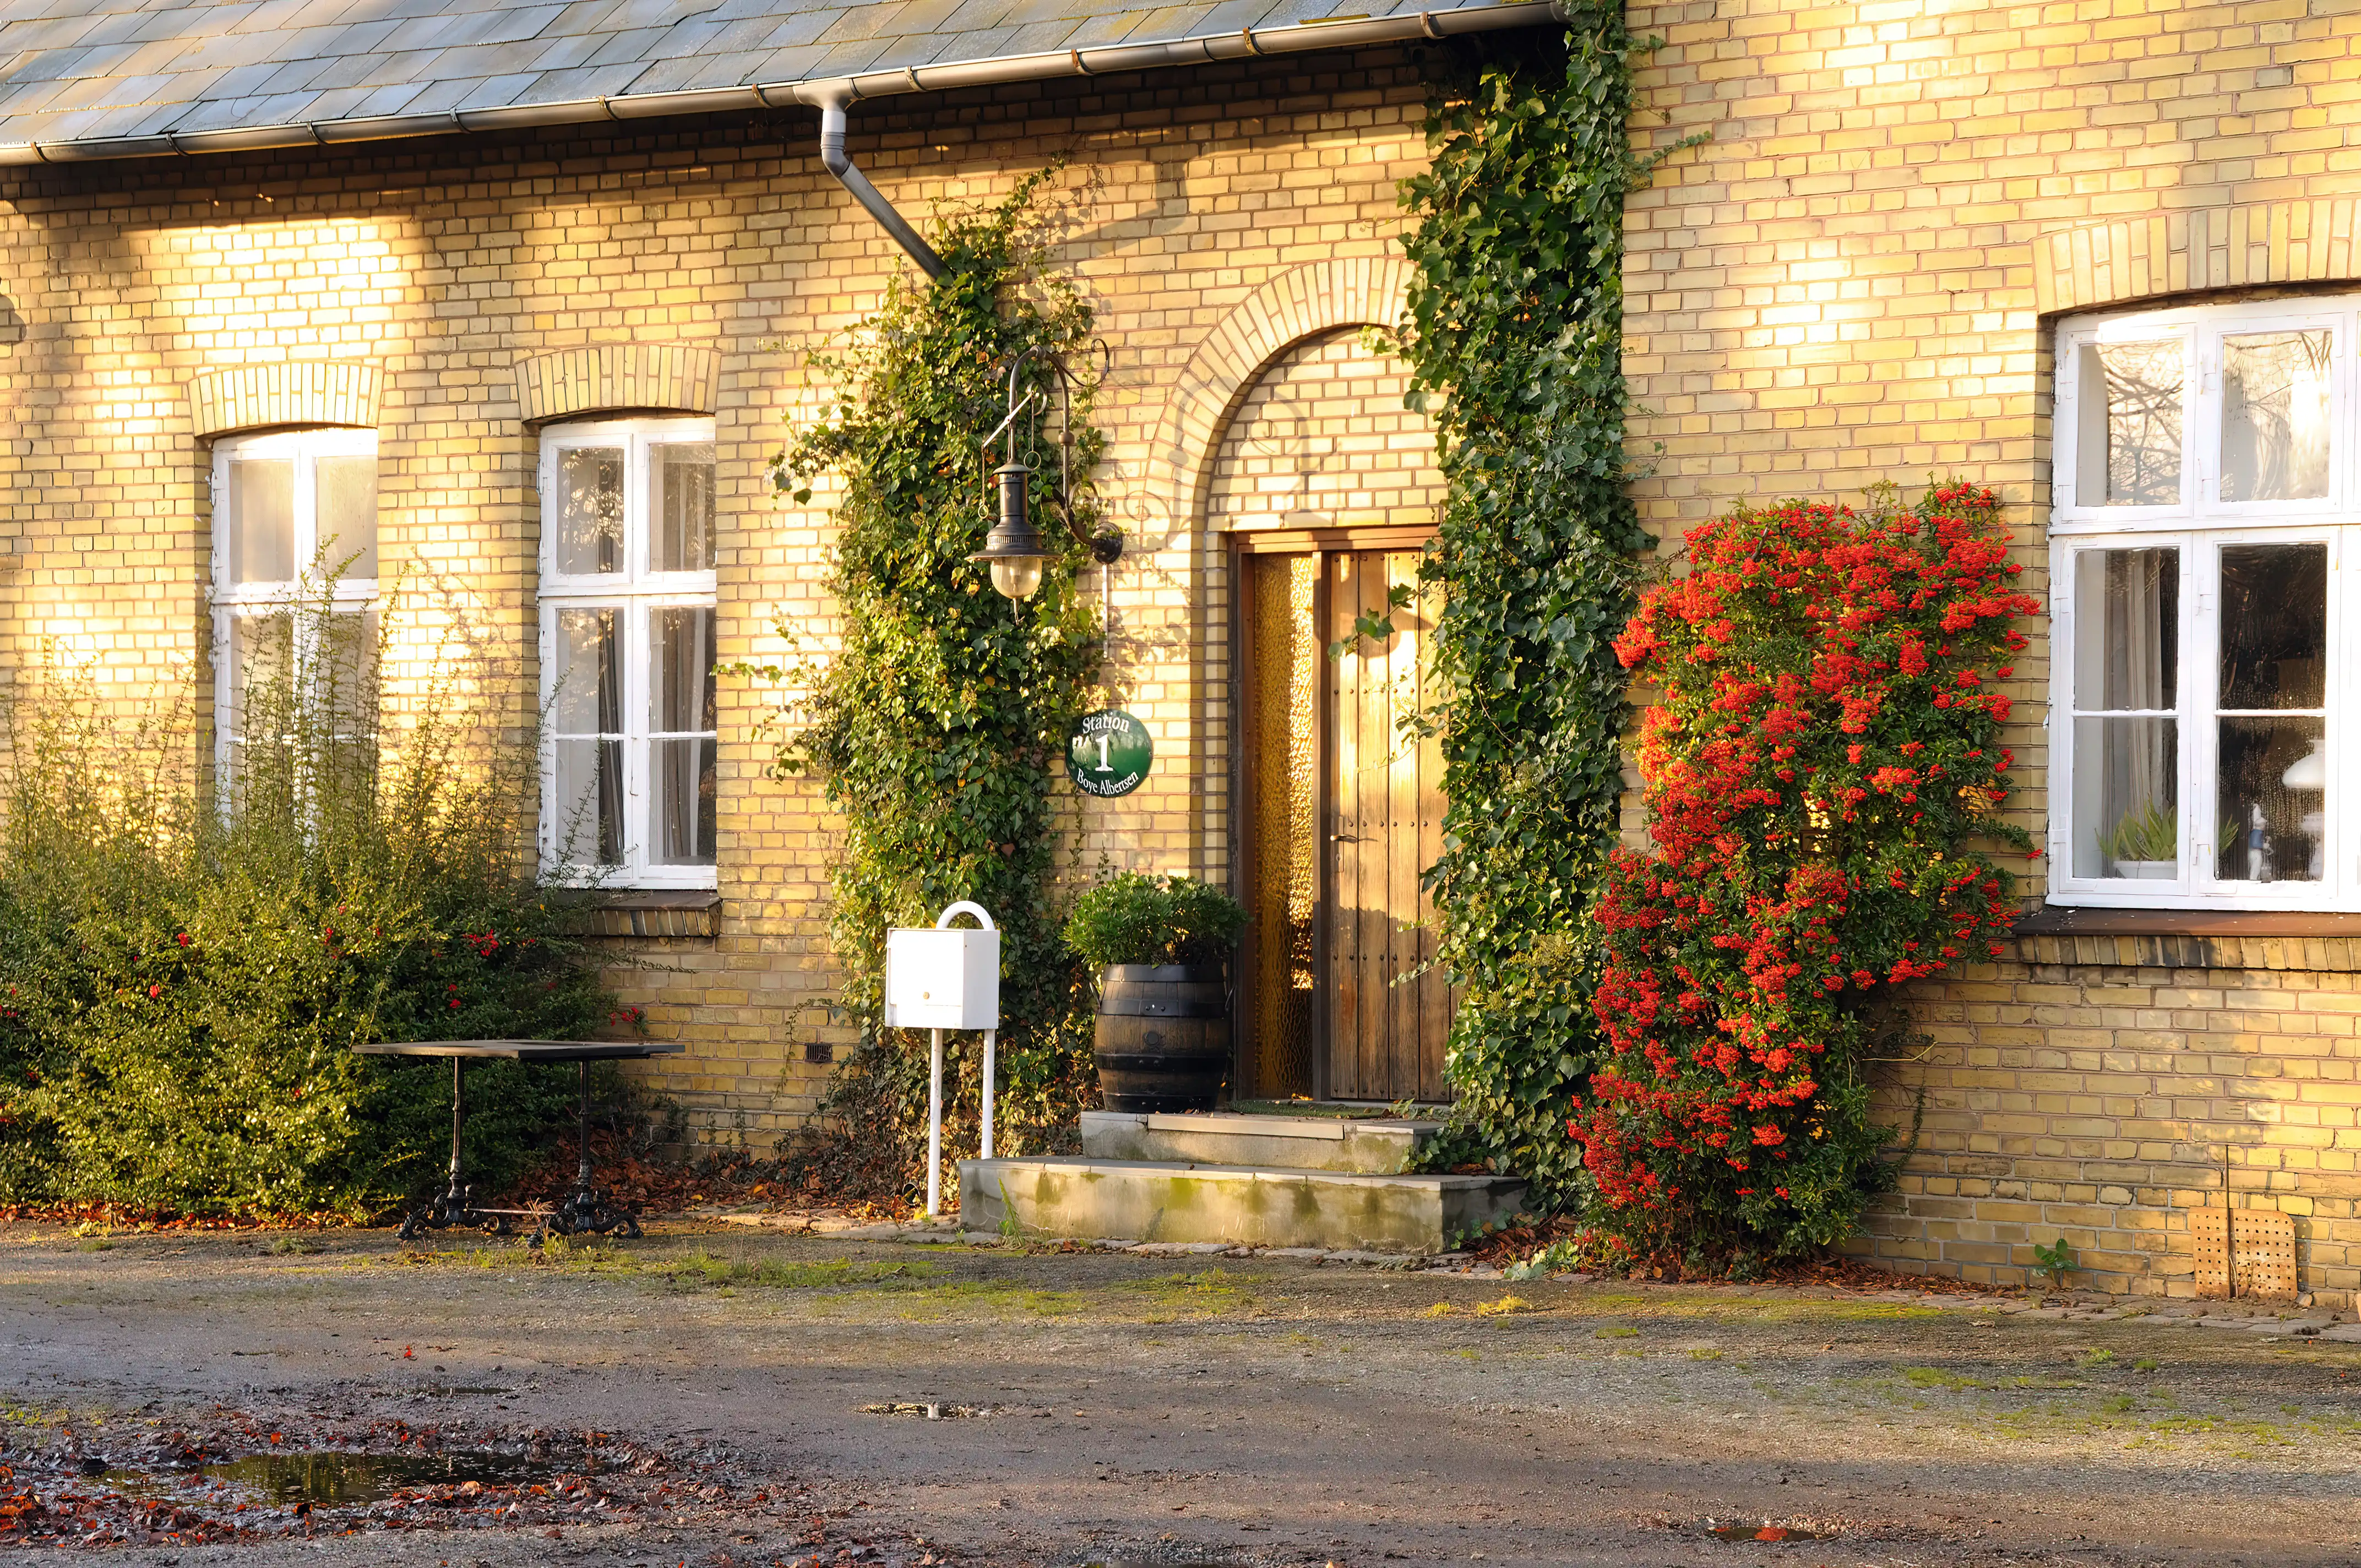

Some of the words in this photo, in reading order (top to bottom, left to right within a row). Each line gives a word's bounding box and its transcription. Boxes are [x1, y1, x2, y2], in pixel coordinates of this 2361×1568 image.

[1082, 714, 1129, 734] Station
[1095, 734, 1113, 771] 1
[1077, 767, 1098, 794] Boye
[1100, 771, 1139, 794] Albertsen
